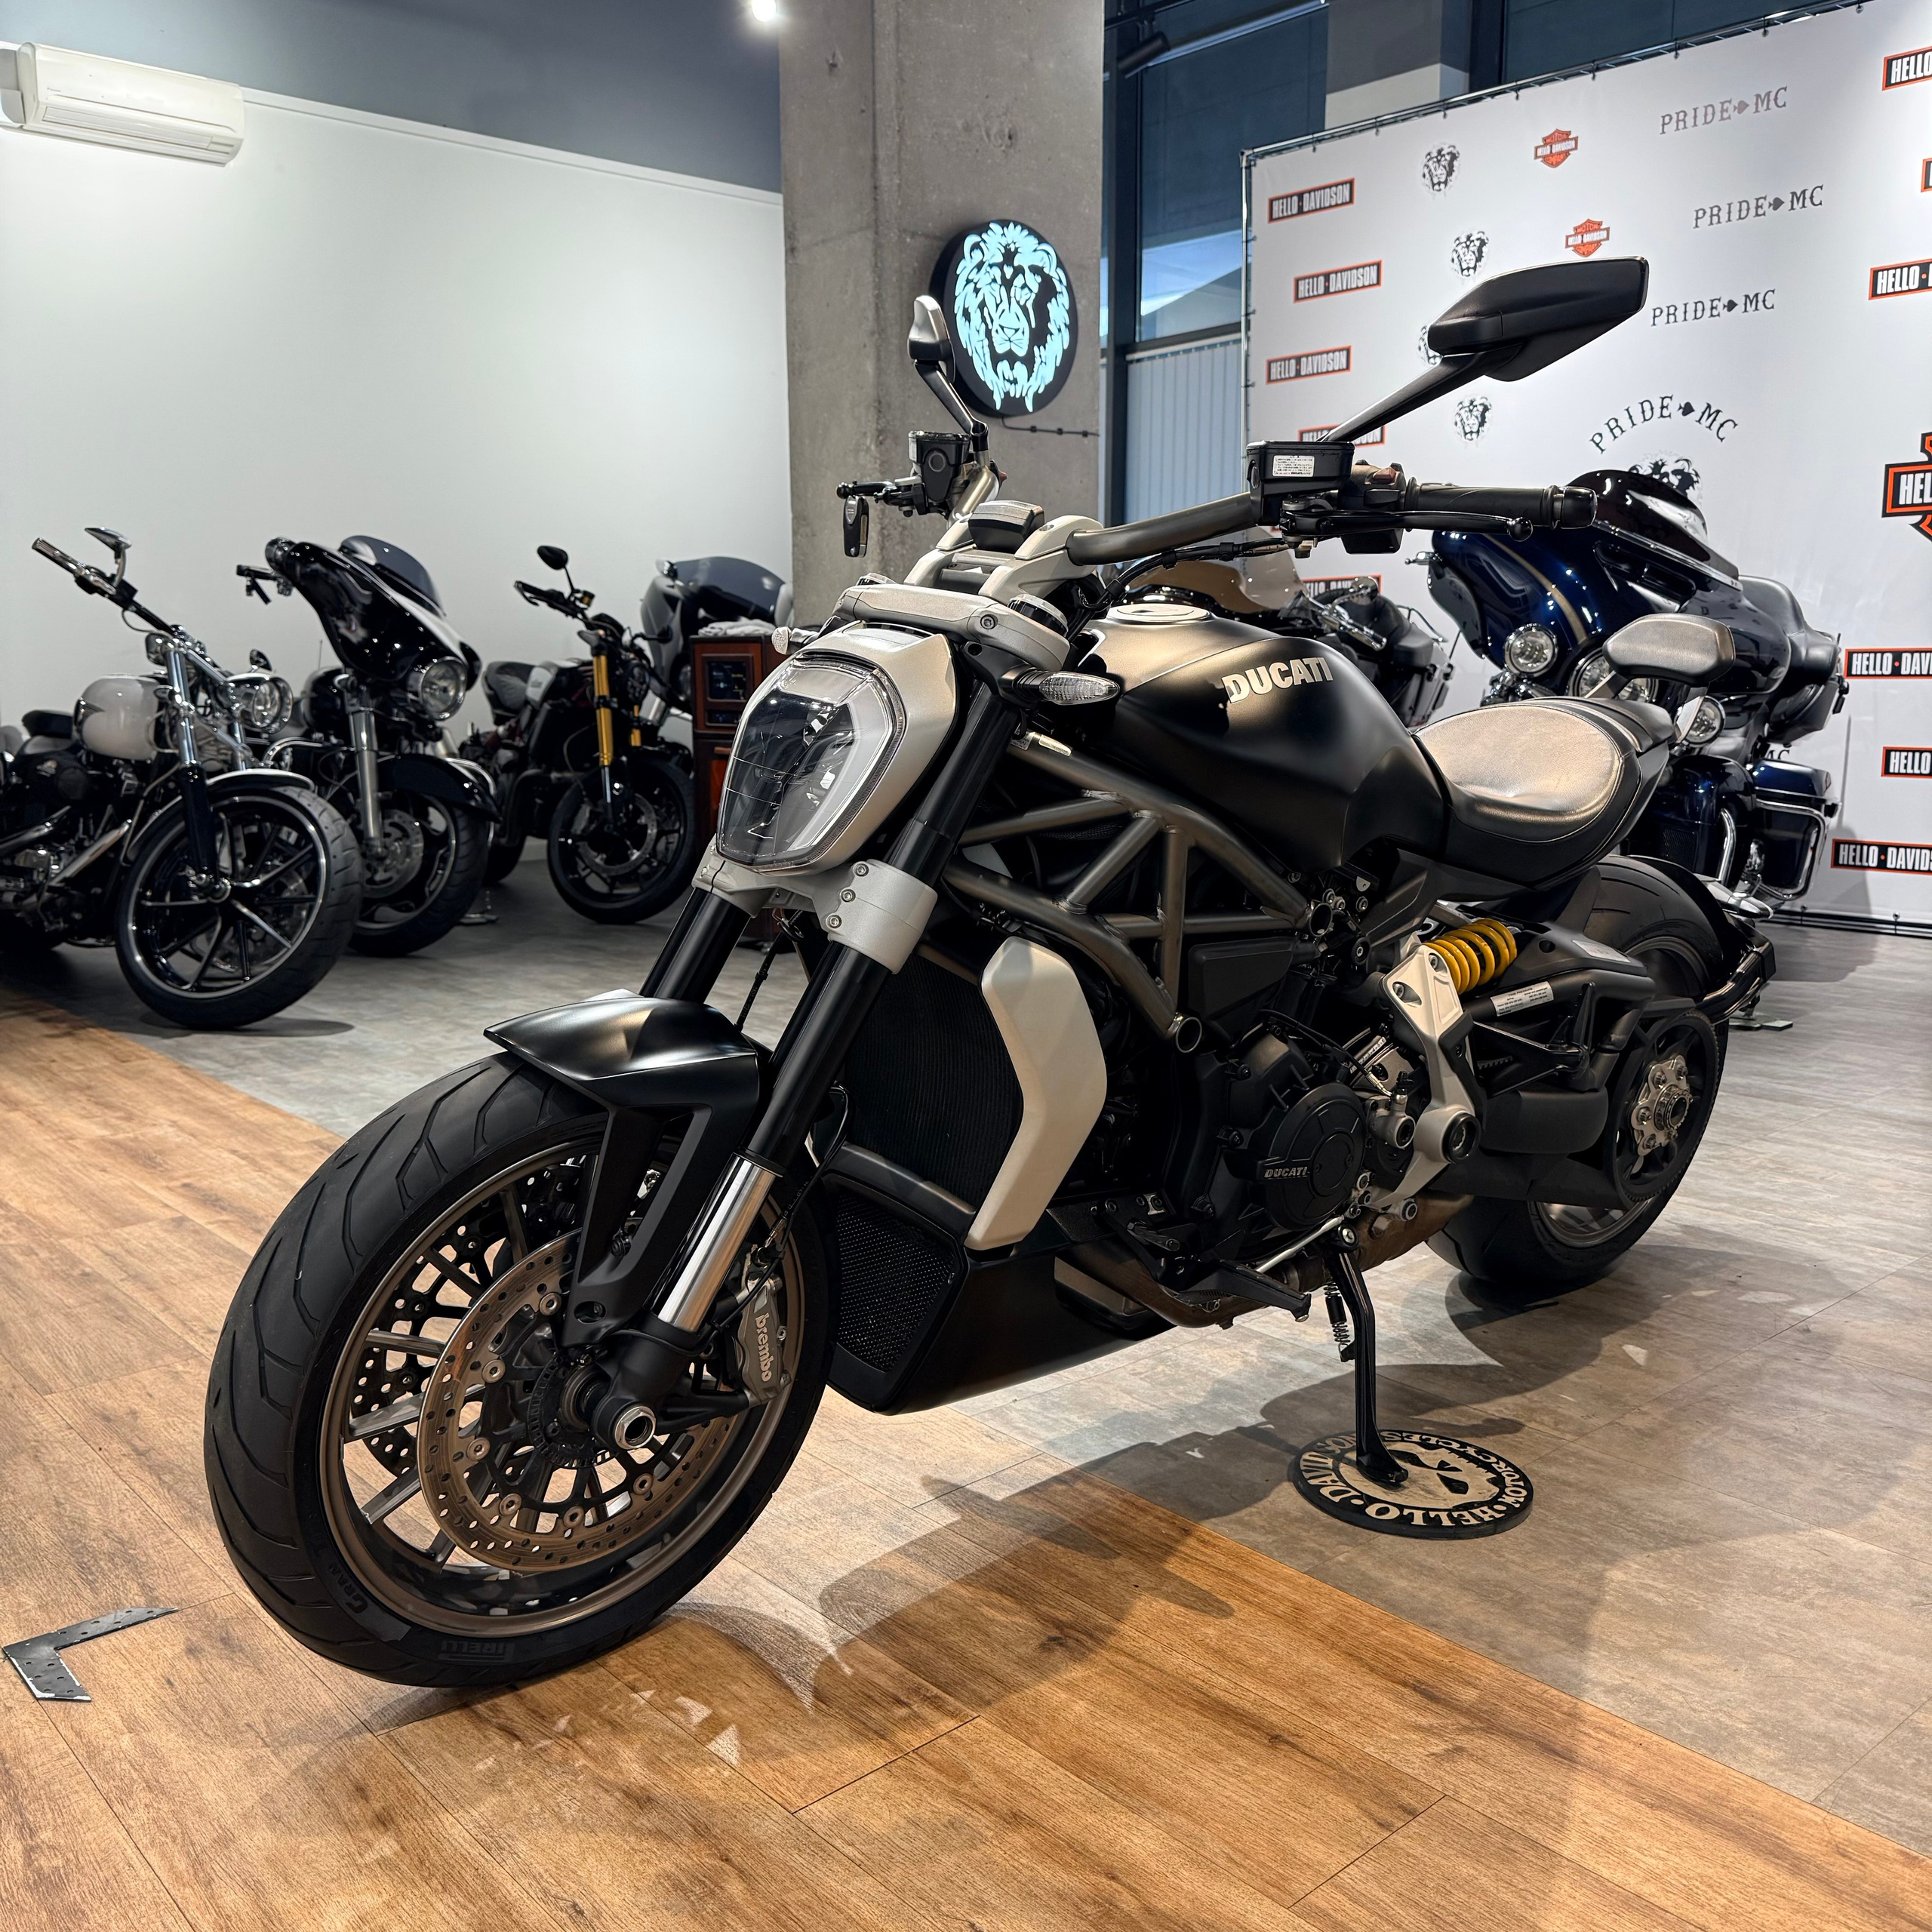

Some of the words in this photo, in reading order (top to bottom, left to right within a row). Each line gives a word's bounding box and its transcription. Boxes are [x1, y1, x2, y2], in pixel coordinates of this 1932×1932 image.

[1890, 51, 1932, 84] HELLO
[1660, 98, 1733, 135] PRIDE
[1753, 86, 1788, 114] MC
[1272, 195, 1298, 219] HELLO
[1303, 183, 1350, 212] DAVIDSON
[1693, 195, 1767, 229] PRIDE
[1788, 184, 1824, 211] MC
[1298, 275, 1324, 299] HELLO
[1329, 265, 1377, 293] DAVIDSON
[1877, 265, 1920, 294] HELLO
[1651, 297, 1721, 326] PRIDE
[1742, 289, 1776, 313] MC
[1270, 358, 1296, 380] HELLO
[1300, 349, 1347, 376] DAVIDSON
[1589, 395, 1674, 454] PRIDE
[1694, 402, 1738, 442] MC
[1221, 657, 1334, 703] DUCATI
[1852, 652, 1893, 675] HELLO
[1889, 751, 1931, 774] HELLO
[1838, 844, 1878, 867] HELLO
[1264, 1167, 1308, 1178] DUCATI
[755, 1312, 774, 1382] brembo
[1380, 1431, 1527, 1508] MOTORCYCLES
[1365, 1503, 1506, 1527] HELLO
